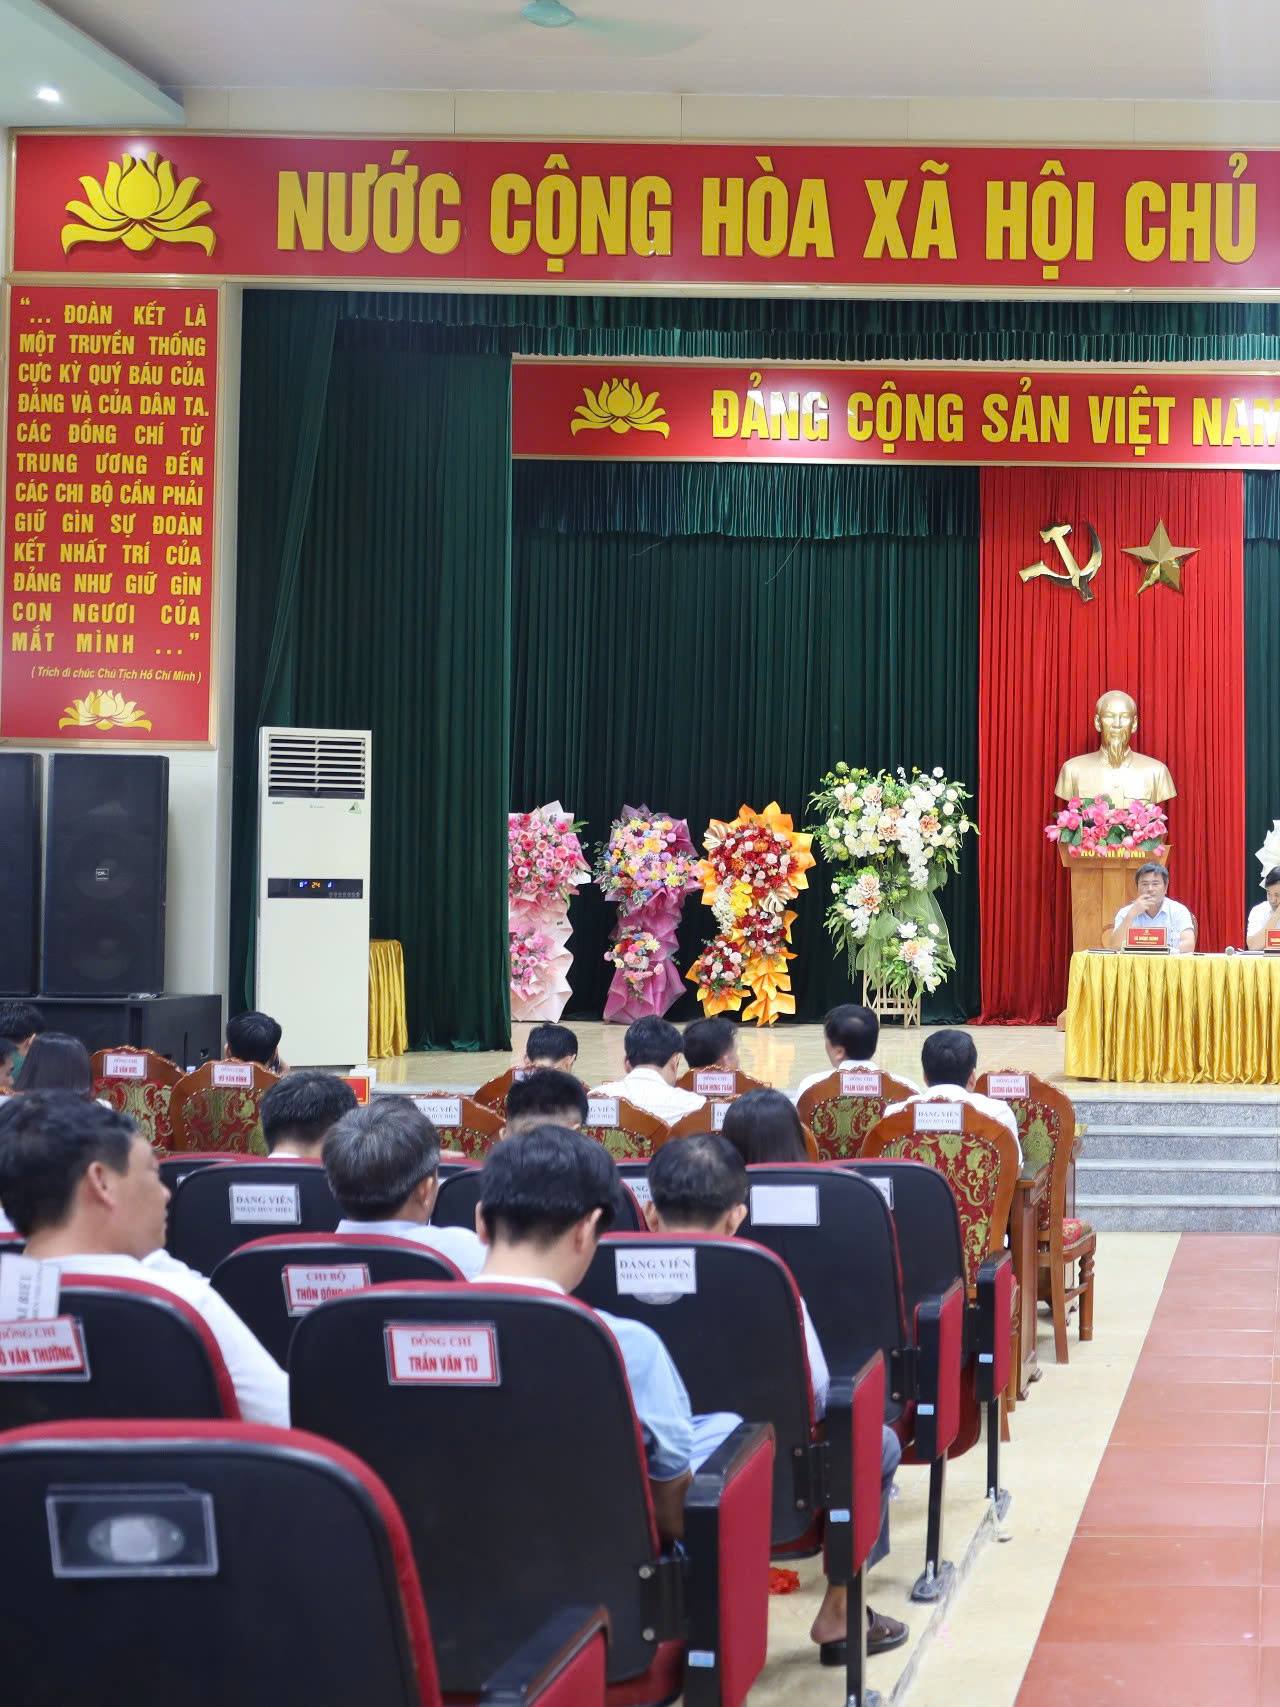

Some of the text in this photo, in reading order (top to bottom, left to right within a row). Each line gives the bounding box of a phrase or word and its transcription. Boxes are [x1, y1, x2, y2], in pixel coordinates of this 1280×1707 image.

[277, 150, 461, 255] NƯỚC
[489, 154, 672, 273] CỘNG
[702, 156, 834, 259] HÒA
[862, 159, 957, 260] XÃ
[985, 159, 1095, 280] HỘI
[1125, 152, 1256, 264] CHỦ
[64, 300, 207, 326] ĐOÀN KẾT LÀ
[19, 329, 206, 356] MỘT TRUYỀN THỐNG
[18, 360, 205, 386] CỰC KỲ QUÝ BÁU CỦA
[18, 387, 209, 416] ĐẢNG VÀ CỦA DÂN TA.
[711, 371, 829, 442] ĐẢNG
[847, 380, 964, 454] CỘNG
[981, 377, 1069, 444] SẢN
[1089, 385, 1176, 457] VIỆT
[15, 479, 203, 507] CÁC CHI BỘ CẦN PHẢI
[12, 599, 200, 626] CON NGƯƠI CỦA
[12, 625, 54, 651] MẮT
[76, 630, 134, 654] MÌNH
